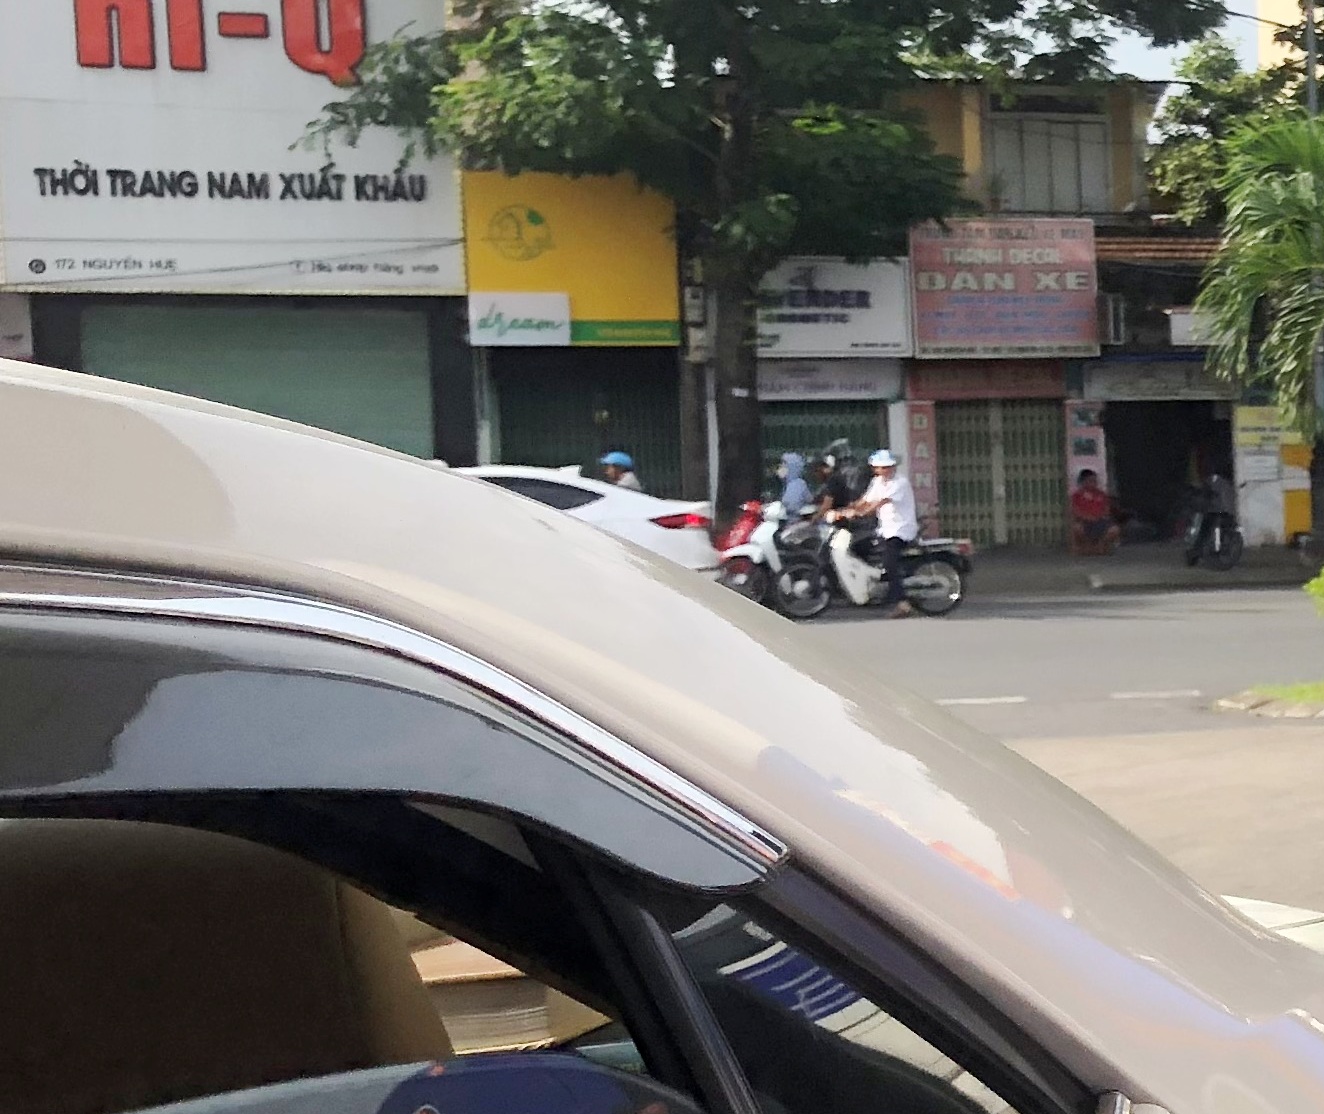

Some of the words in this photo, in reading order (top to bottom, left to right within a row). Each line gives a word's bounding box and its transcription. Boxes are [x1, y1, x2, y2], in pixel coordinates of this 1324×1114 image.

[34, 159, 98, 197] THỜI
[106, 169, 199, 198] TRANG
[207, 170, 270, 200] NAM
[1034, 270, 1089, 291] XE
